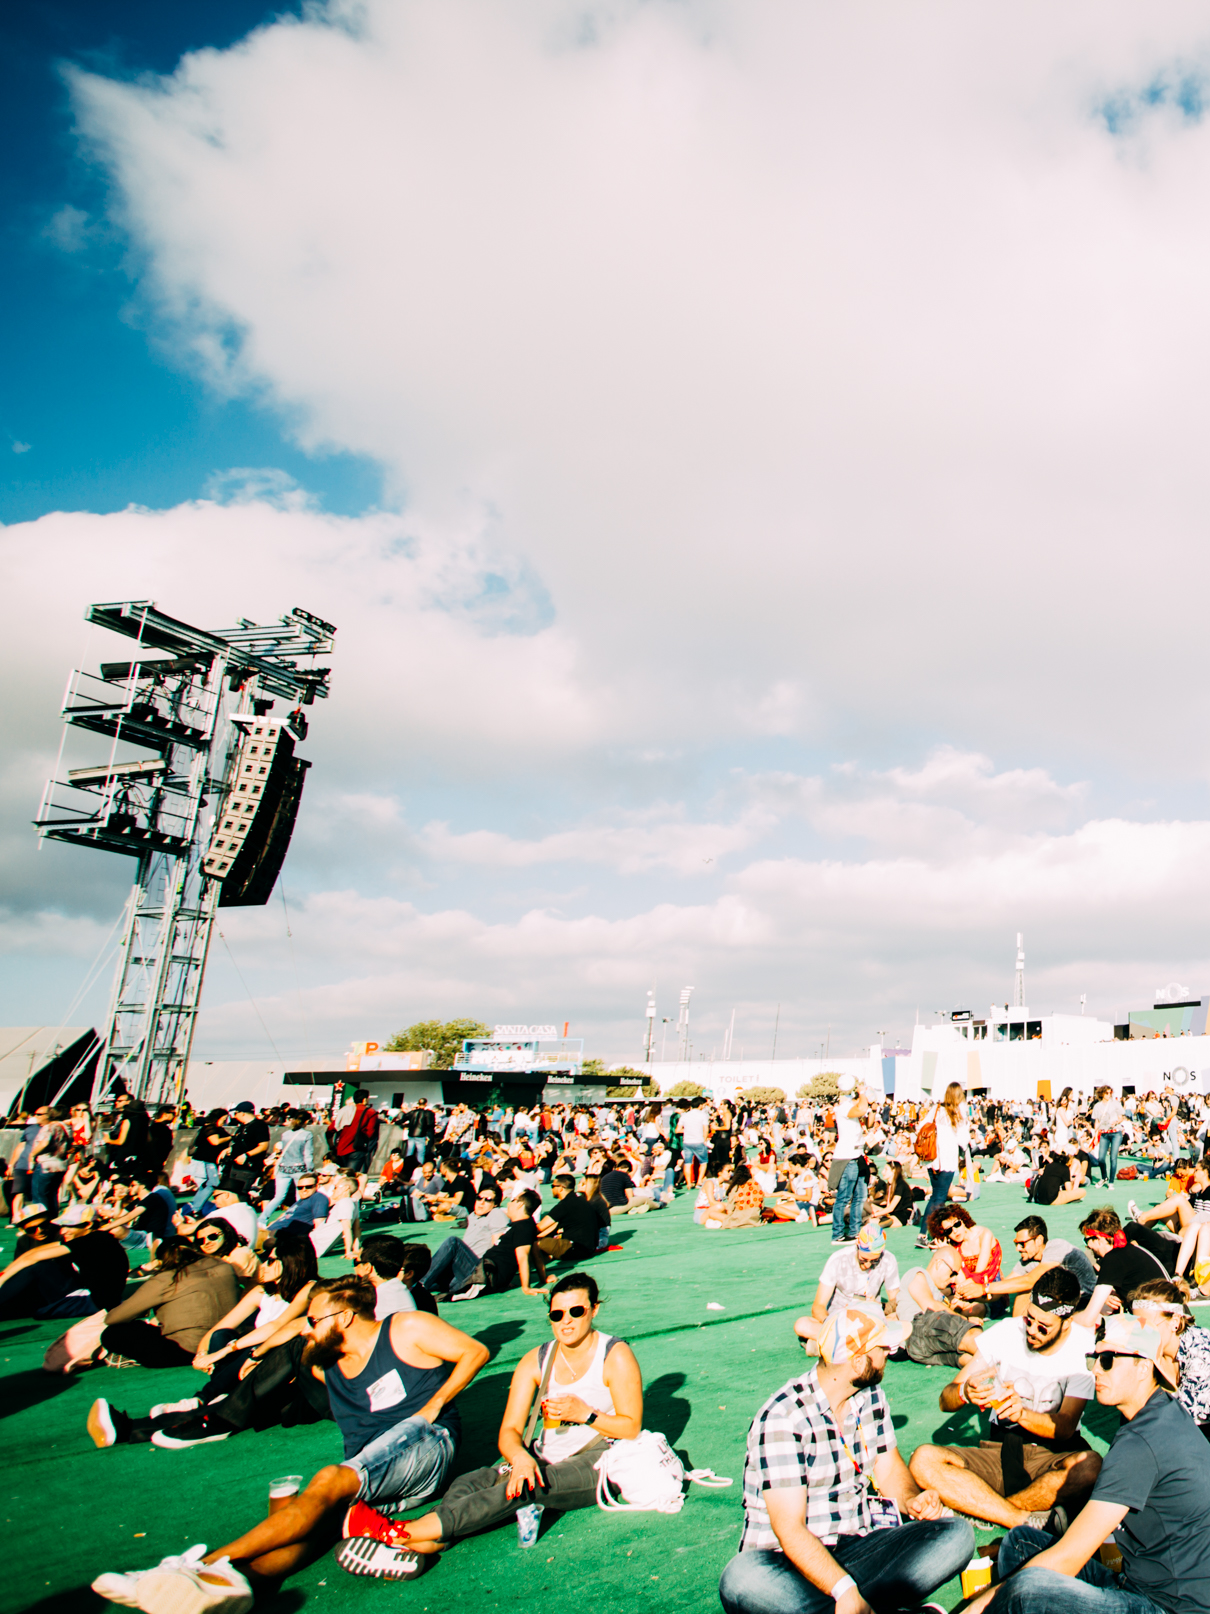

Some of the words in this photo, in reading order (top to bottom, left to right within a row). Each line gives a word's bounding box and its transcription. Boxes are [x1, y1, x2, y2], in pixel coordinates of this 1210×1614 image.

[1155, 982, 1190, 1002] NOS
[494, 1024, 529, 1035] SANTA
[529, 1024, 557, 1035] CASA
[351, 1041, 379, 1055] TAP
[460, 1072, 493, 1082] Heineken
[547, 1075, 574, 1084] Heineken
[620, 1077, 643, 1085] Heineken
[719, 1075, 754, 1083] TOILET
[1163, 1066, 1197, 1087] NOS
